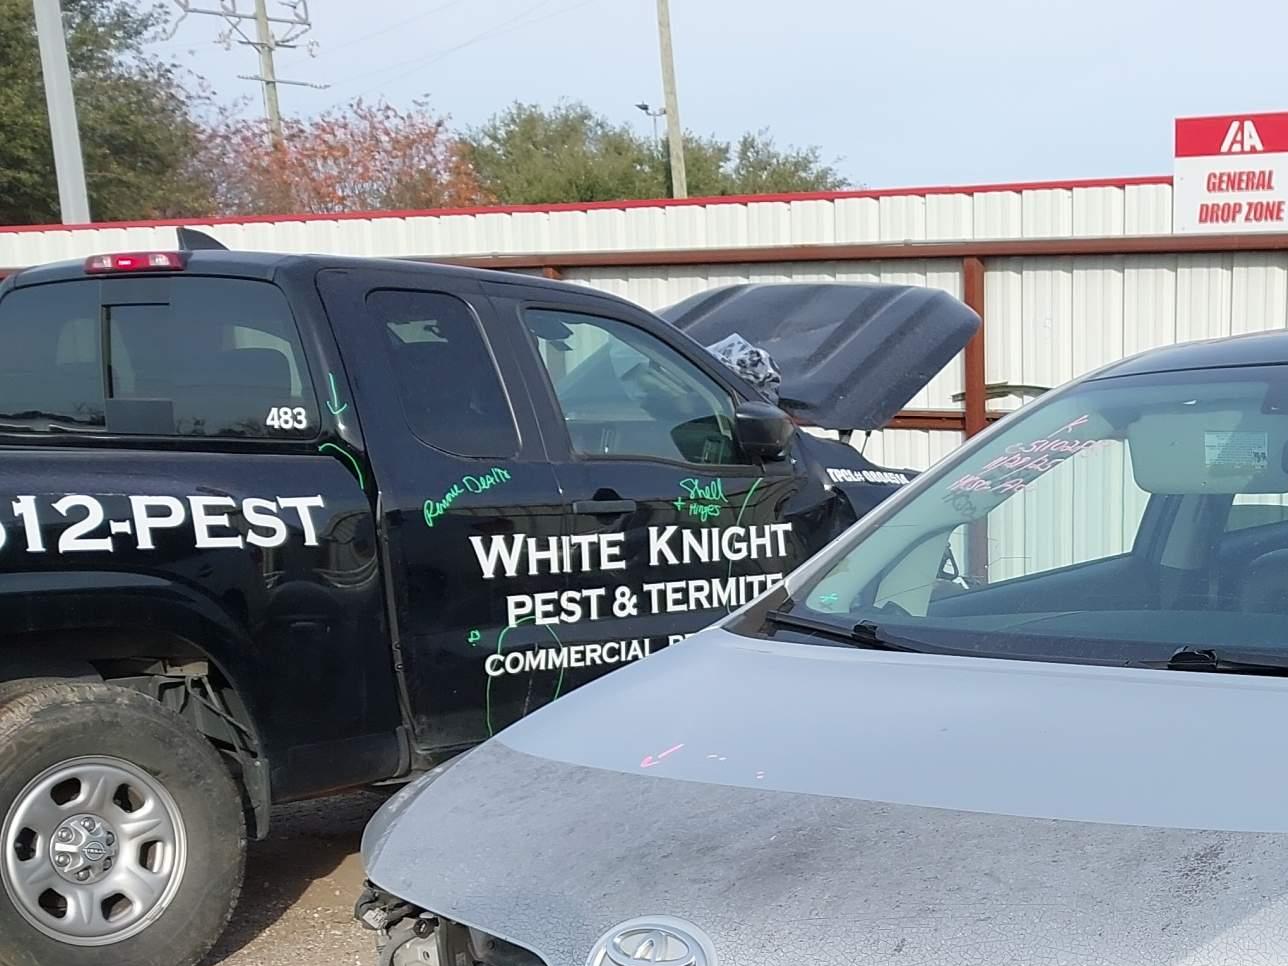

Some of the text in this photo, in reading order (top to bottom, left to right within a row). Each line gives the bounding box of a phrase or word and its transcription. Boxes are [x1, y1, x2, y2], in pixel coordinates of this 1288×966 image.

[1206, 170, 1274, 193] GENERAL
[1199, 201, 1286, 224] DROP ZONE
[265, 406, 307, 430] 483
[0, 494, 325, 553] 12-PEST
[468, 522, 793, 578] WHITE KNIGHT
[506, 587, 606, 628] PEST
[612, 585, 638, 618] &
[484, 638, 651, 677] COMMERCIAL
